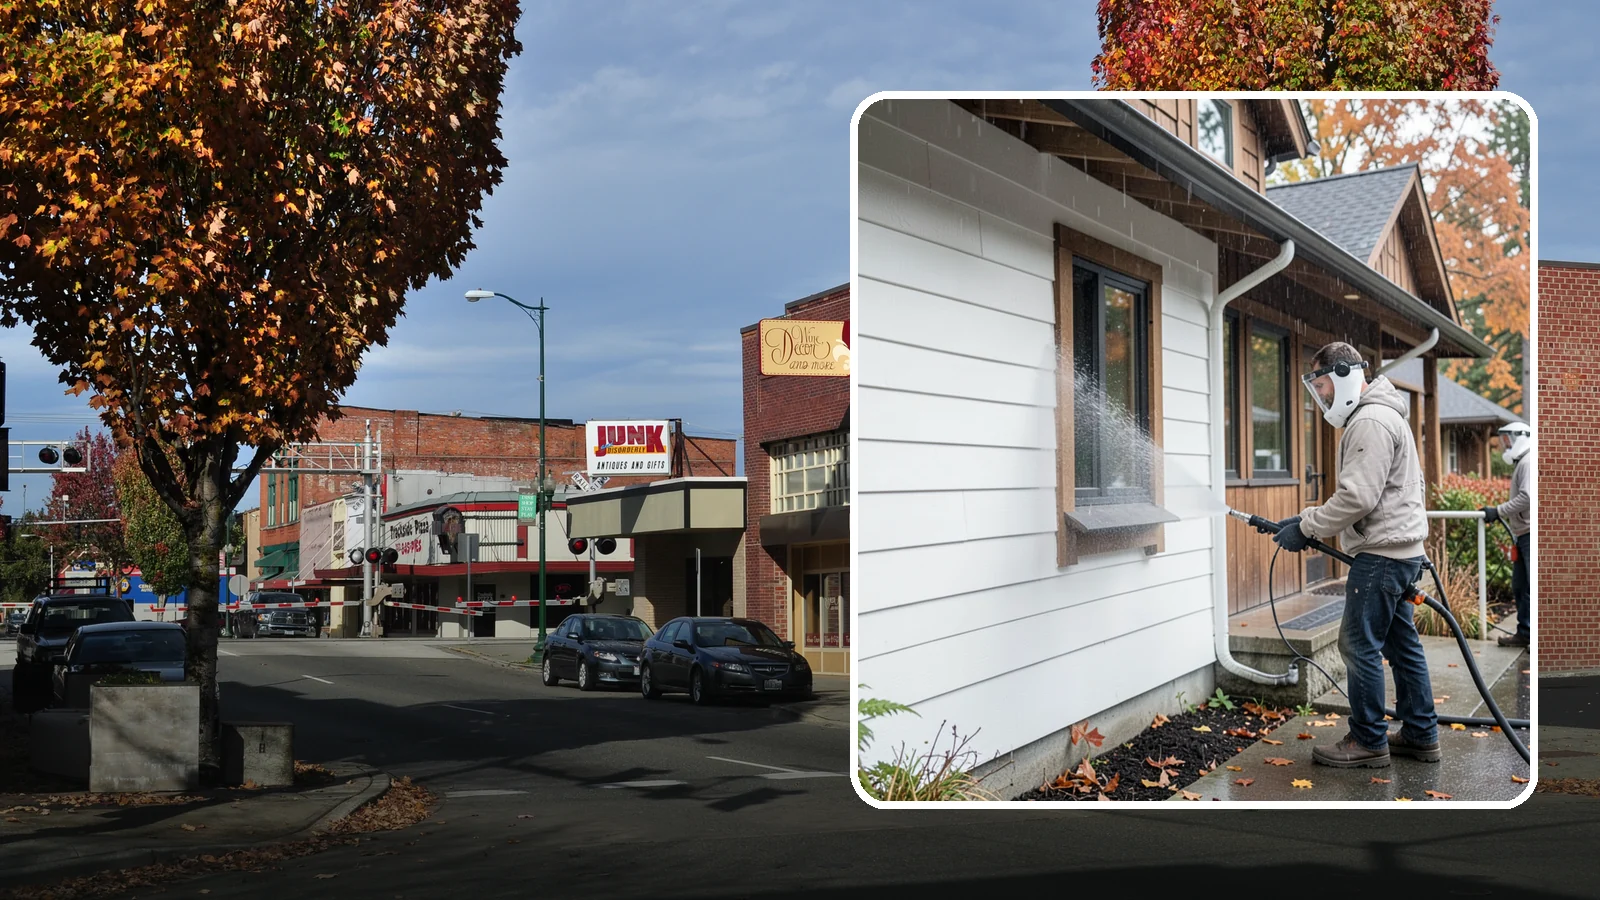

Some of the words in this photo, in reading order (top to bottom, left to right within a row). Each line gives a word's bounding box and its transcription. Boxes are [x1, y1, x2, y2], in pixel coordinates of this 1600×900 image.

[765, 327, 831, 366] Decor
[595, 425, 665, 457] JUNK
[607, 446, 646, 454] DISORDERLY
[597, 461, 628, 470] ANTIQUES
[631, 461, 644, 470] AND
[647, 460, 665, 469] GIFTS
[590, 476, 608, 492] SING
[415, 519, 429, 535] Pizza
